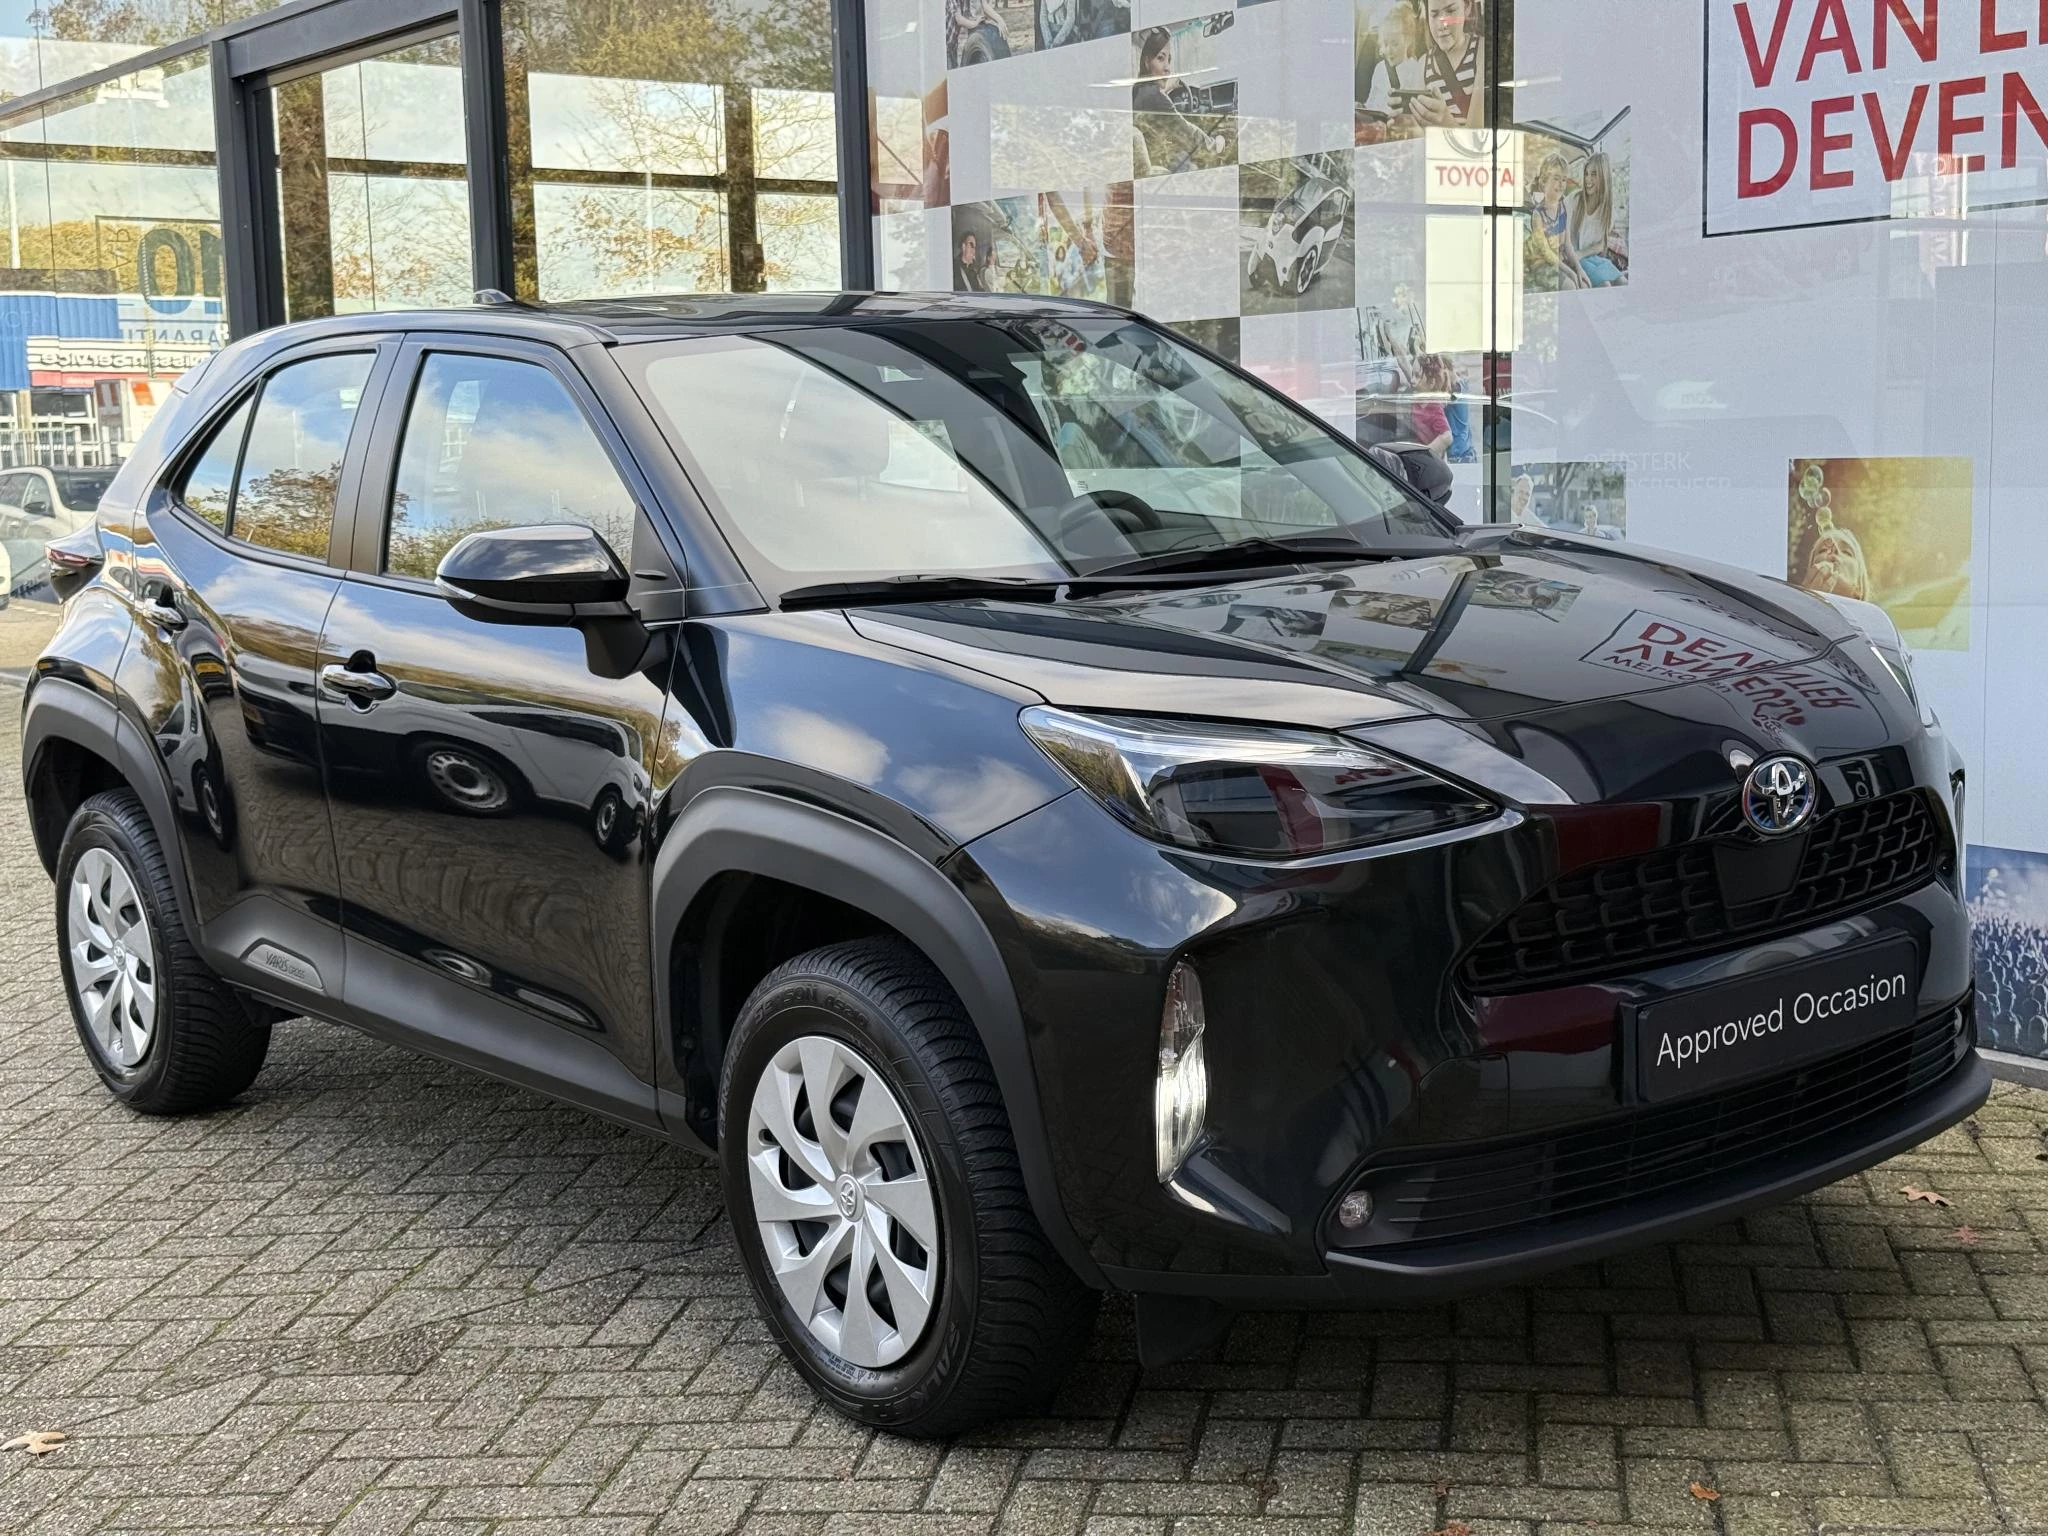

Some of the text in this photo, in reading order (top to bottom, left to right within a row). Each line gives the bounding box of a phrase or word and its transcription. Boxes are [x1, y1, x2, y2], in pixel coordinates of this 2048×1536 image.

[1732, 0, 2048, 88] VAN L
[1434, 166, 1515, 188] TOYOA
[1737, 71, 2048, 200] DEVEN
[1656, 973, 1906, 1069] Approved Occasion
